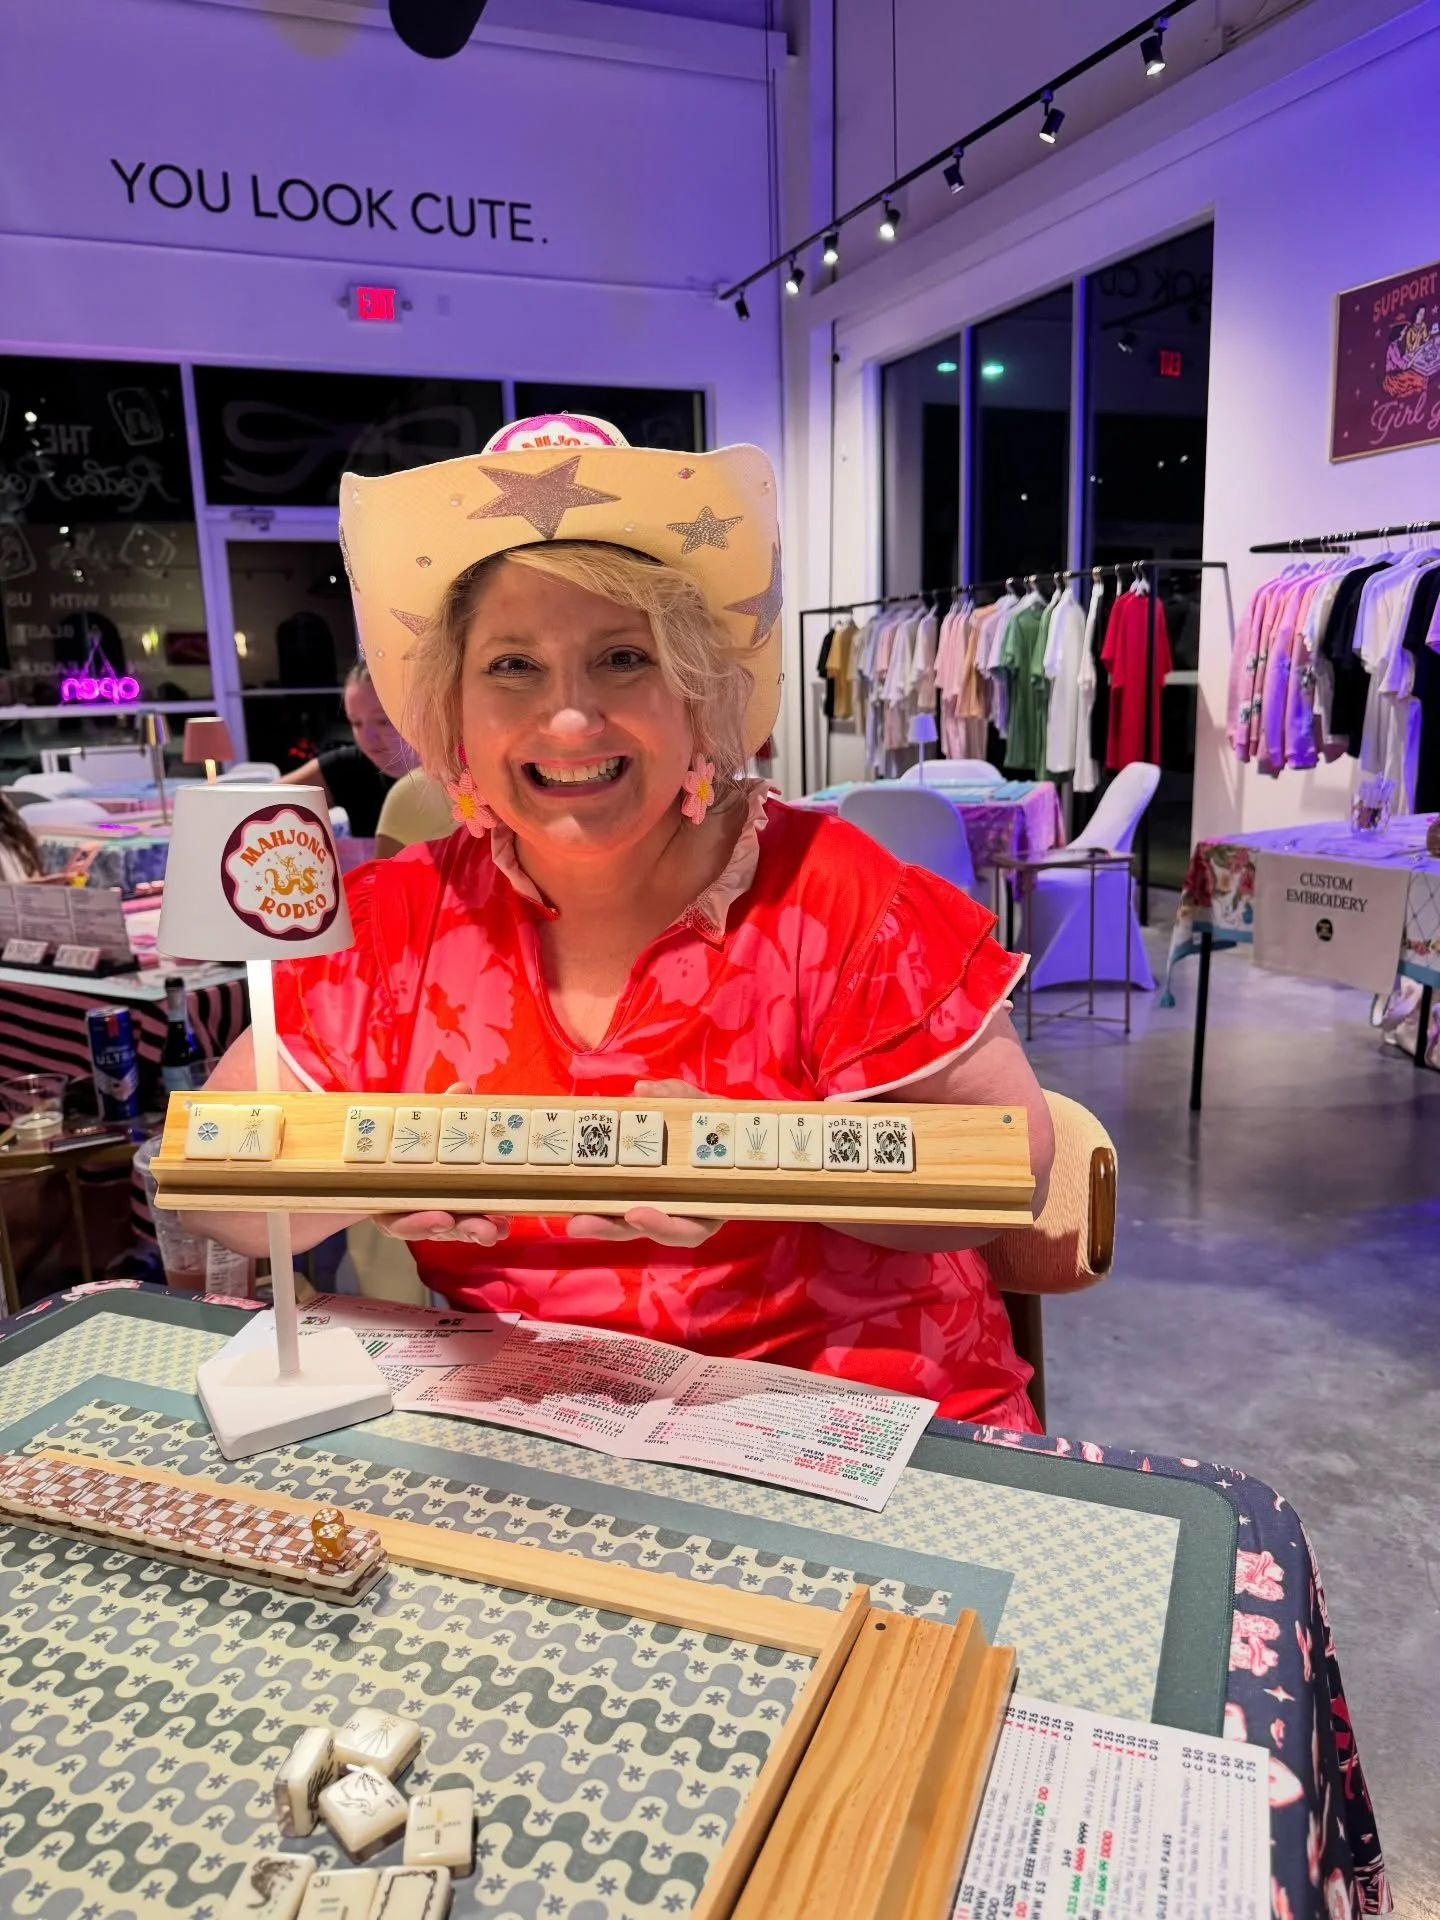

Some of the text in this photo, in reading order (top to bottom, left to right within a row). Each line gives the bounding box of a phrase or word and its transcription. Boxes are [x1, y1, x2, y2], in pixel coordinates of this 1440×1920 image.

[110, 158, 549, 244] YOU LOOK CUTE.
[1373, 272, 1438, 322] SUPPORT
[1370, 392, 1426, 444] Girl
[240, 829, 327, 867] MAHJONG
[1300, 872, 1353, 891] CUSTOM
[1286, 888, 1368, 912] EMBROIDERY
[259, 893, 327, 919] RODEO
[250, 1108, 262, 1117] N
[350, 1109, 358, 1120] 2
[411, 1111, 421, 1121] E
[458, 1111, 468, 1121] E
[490, 1111, 498, 1122] 3
[546, 1112, 557, 1122] W
[578, 1113, 613, 1124] JOKER
[635, 1114, 648, 1124] W
[696, 1115, 705, 1126] 4
[753, 1117, 760, 1126] S
[797, 1118, 804, 1127] S
[828, 1118, 862, 1129] JOKER
[873, 1119, 907, 1131] JOKER
[1016, 1708, 1027, 1720] 25
[1028, 1712, 1038, 1723] 25
[1039, 1715, 1050, 1726] 25
[1051, 1718, 1061, 1729] 25
[1063, 1720, 1074, 1732] 30
[1092, 1728, 1103, 1739] 25
[1103, 1730, 1114, 1741] 25
[1115, 1733, 1125, 1744] 25
[1126, 1735, 1136, 1746] 30
[1137, 1738, 1147, 1749] 25
[1149, 1739, 1158, 1751] 30
[1182, 1747, 1192, 1758] 50
[1193, 1749, 1203, 1761] 50
[1206, 1752, 1216, 1764] 50
[1220, 1755, 1229, 1766] 50
[1234, 1758, 1243, 1769] 50
[1037, 1786, 1048, 1800] DD
[1034, 1802, 1046, 1815] DD
[1161, 1834, 1172, 1862] PAIRS
[1061, 1849, 1072, 1867] 369
[1159, 1868, 1169, 1889] AND
